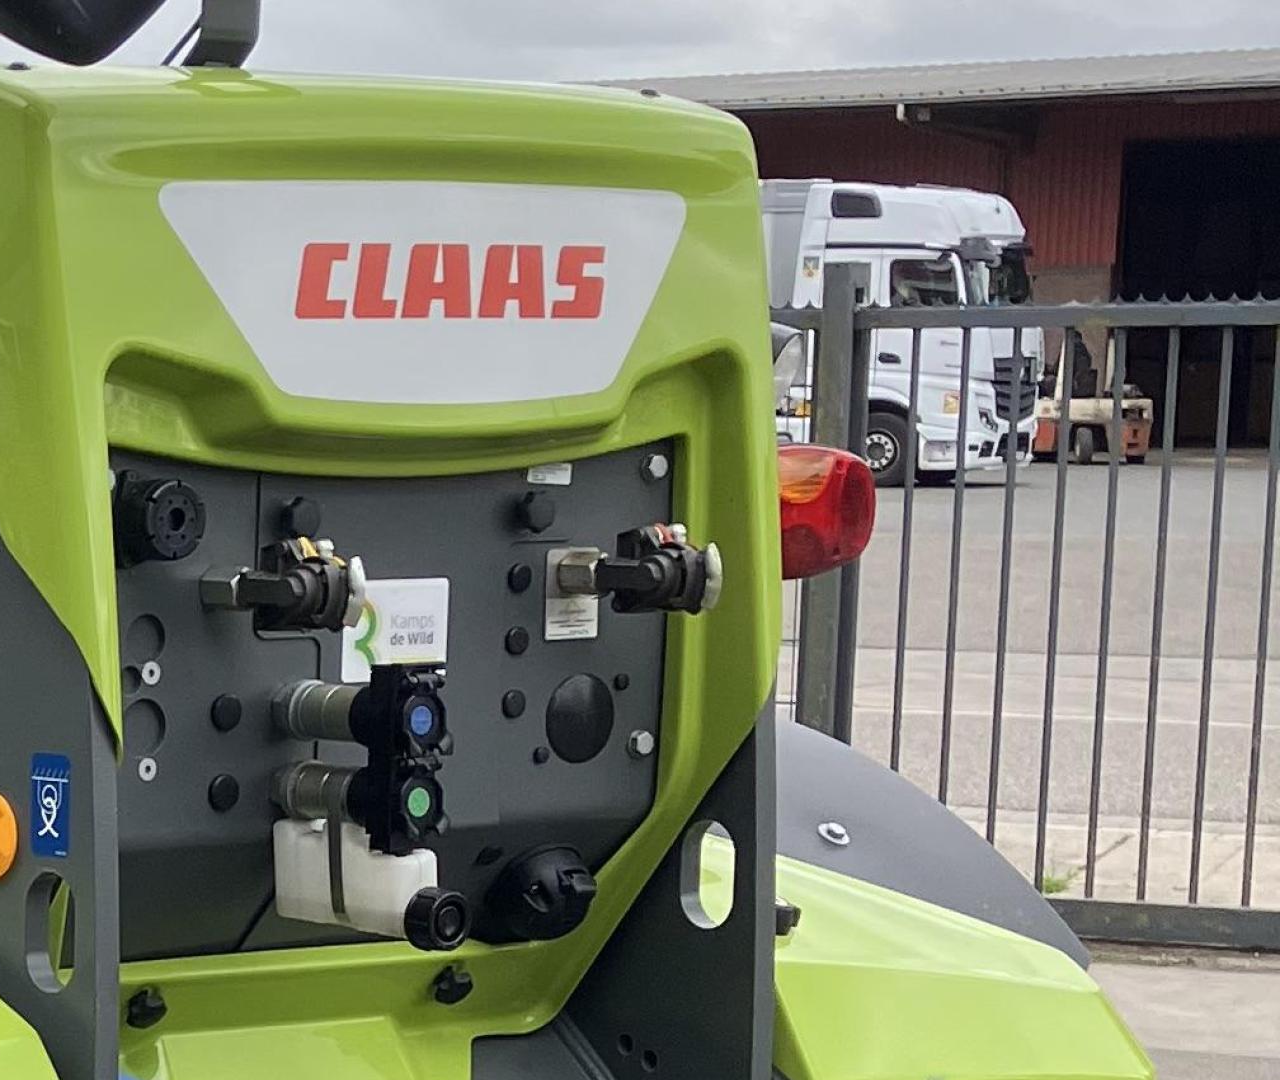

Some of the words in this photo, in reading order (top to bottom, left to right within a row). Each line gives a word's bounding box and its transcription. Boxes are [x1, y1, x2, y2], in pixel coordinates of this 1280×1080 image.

[294, 243, 606, 319] CLAAS
[390, 615, 435, 630] Kamps
[390, 632, 406, 646] de
[408, 631, 434, 645] Wild
